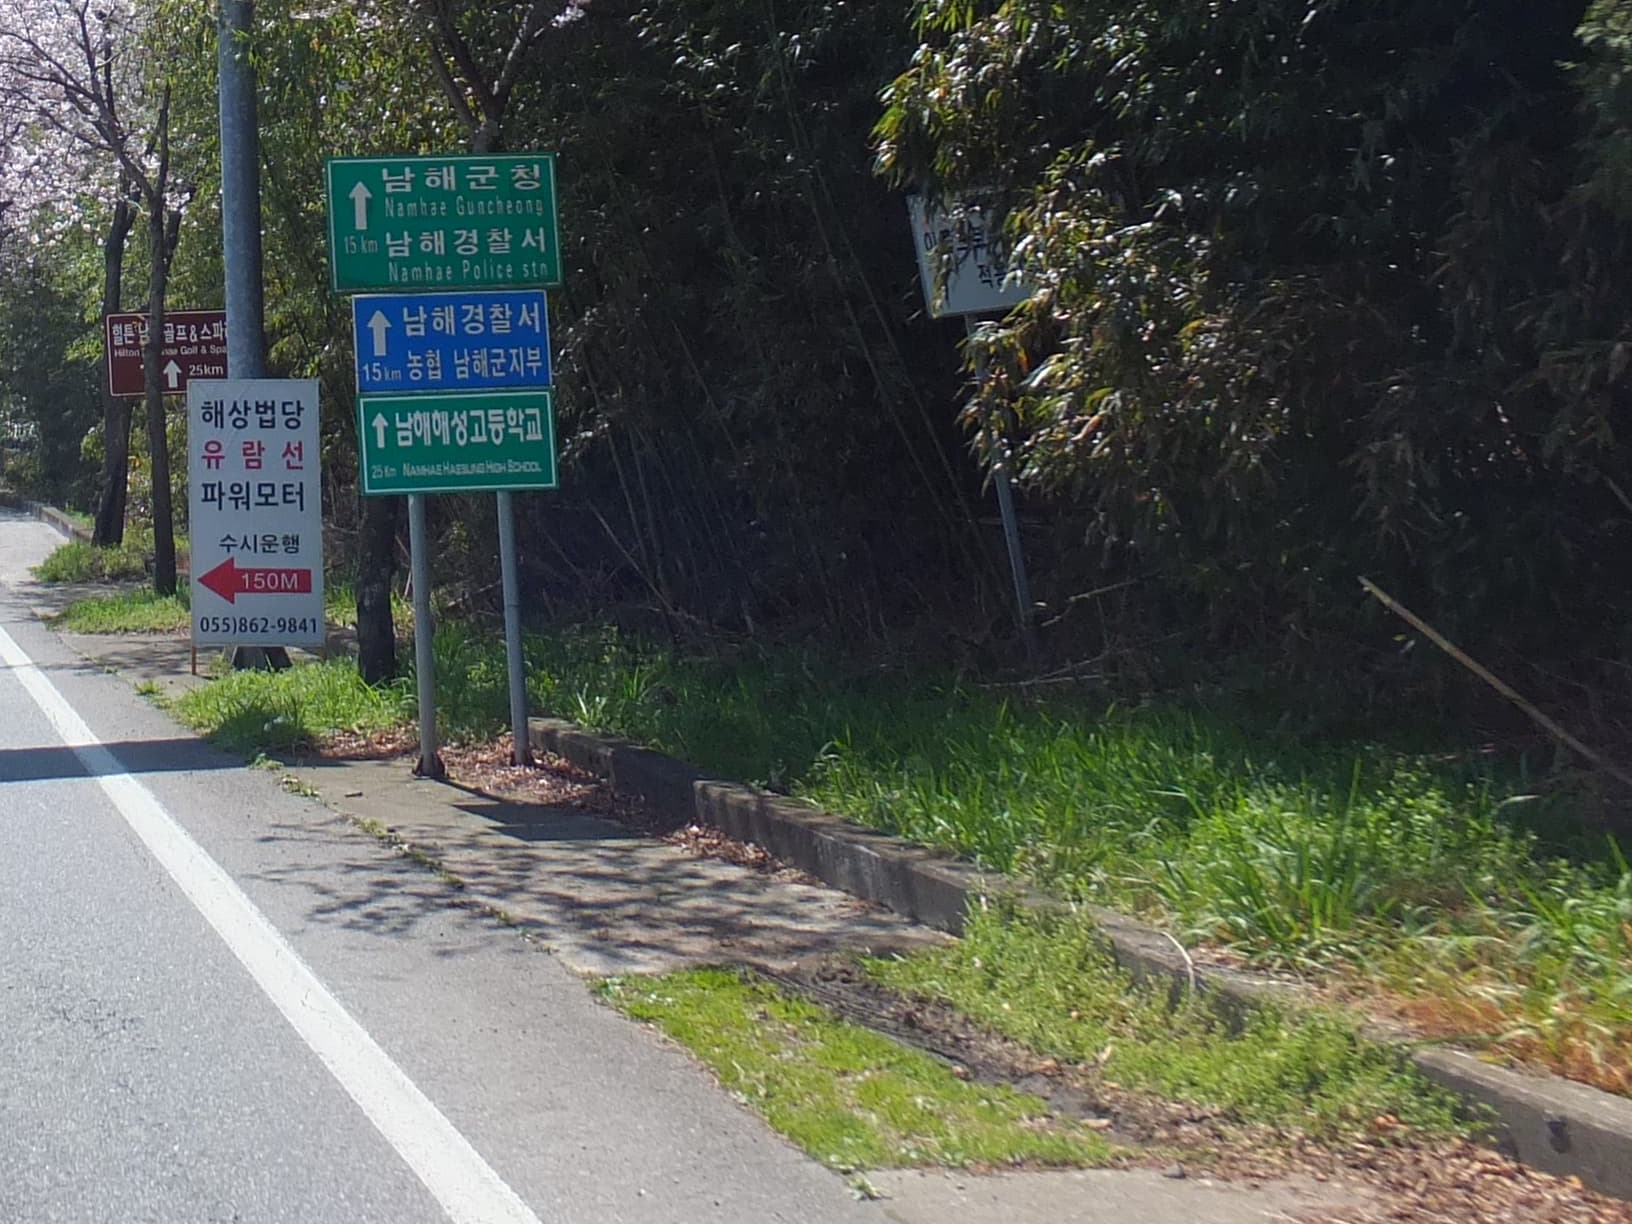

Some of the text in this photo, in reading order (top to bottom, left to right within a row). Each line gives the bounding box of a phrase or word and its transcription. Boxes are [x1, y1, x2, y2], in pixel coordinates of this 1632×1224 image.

[381, 164, 541, 193] 남해군청
[385, 195, 544, 218] Namhae Guncheong
[385, 227, 546, 258] 남해경찰서
[388, 261, 453, 282] Namhae
[462, 259, 513, 279] Police
[402, 302, 541, 337] 남해경찰서
[180, 345, 199, 355] Golf
[406, 346, 542, 380] 농협 남해군지부
[188, 363, 224, 376] 25km
[200, 400, 305, 430] 해상법당
[395, 407, 543, 447] 남해해성고등학교
[200, 481, 305, 512] 파워모터
[218, 534, 301, 554] 수시운행
[241, 572, 299, 590] 150M
[199, 616, 318, 634] 055)862-9841
